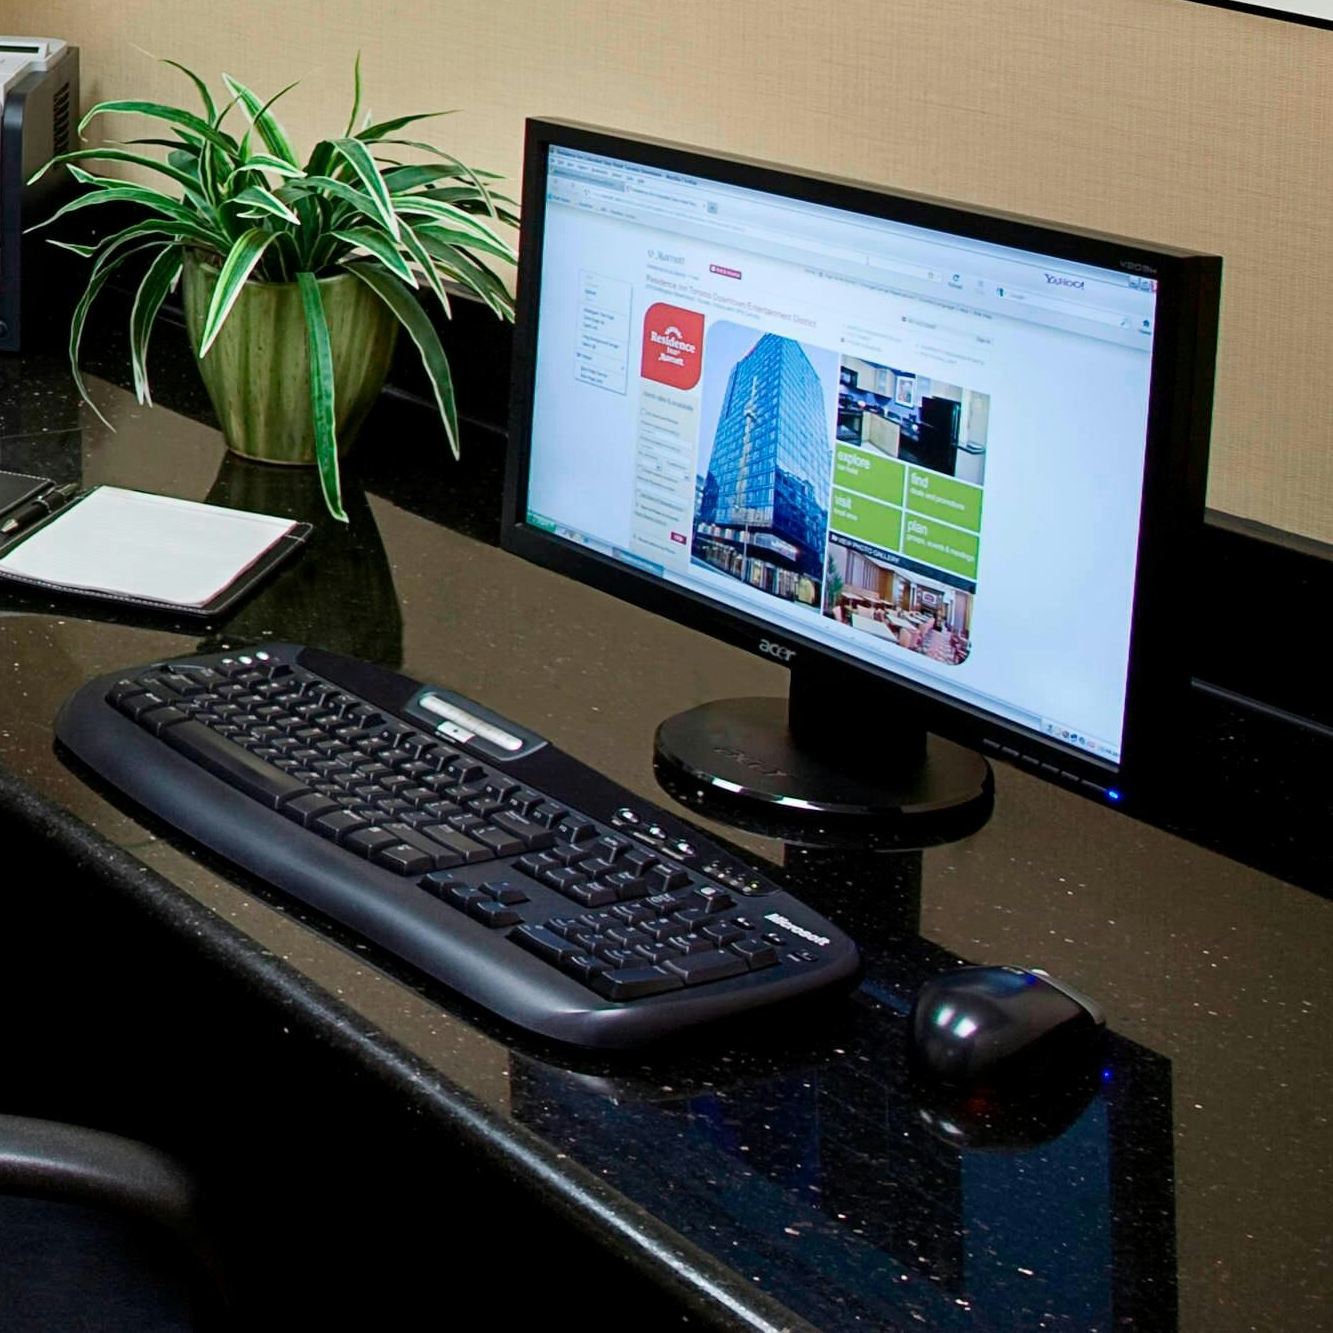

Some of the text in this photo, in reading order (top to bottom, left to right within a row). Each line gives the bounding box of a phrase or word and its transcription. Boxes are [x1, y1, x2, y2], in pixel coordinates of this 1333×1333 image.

[650, 330, 697, 355] Residence
[837, 451, 871, 470] explore
[911, 472, 930, 490] find
[907, 520, 929, 537] plan
[758, 638, 797, 662] acer
[764, 912, 830, 947] Microsoft
